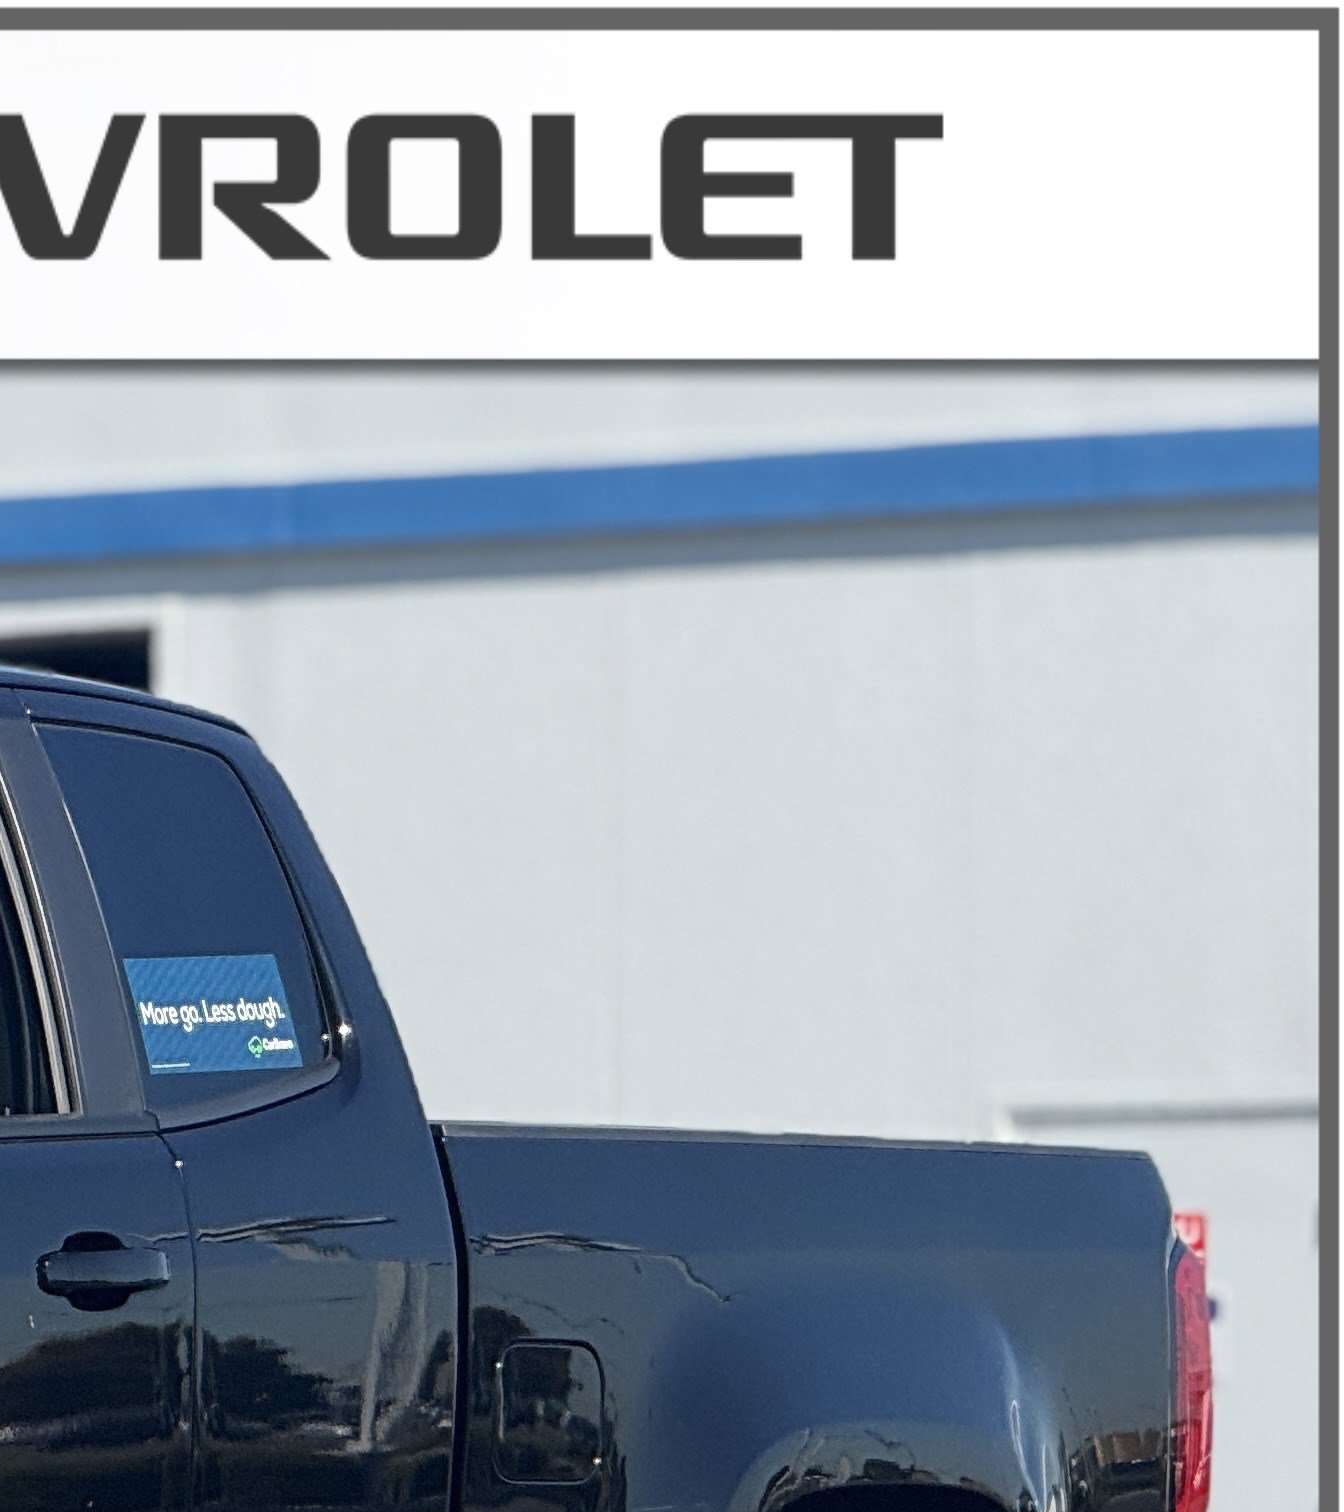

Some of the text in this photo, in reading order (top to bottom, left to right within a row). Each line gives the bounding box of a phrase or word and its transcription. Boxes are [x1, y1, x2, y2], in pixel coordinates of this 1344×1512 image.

[139, 996, 286, 1032] More go. Less dough.
